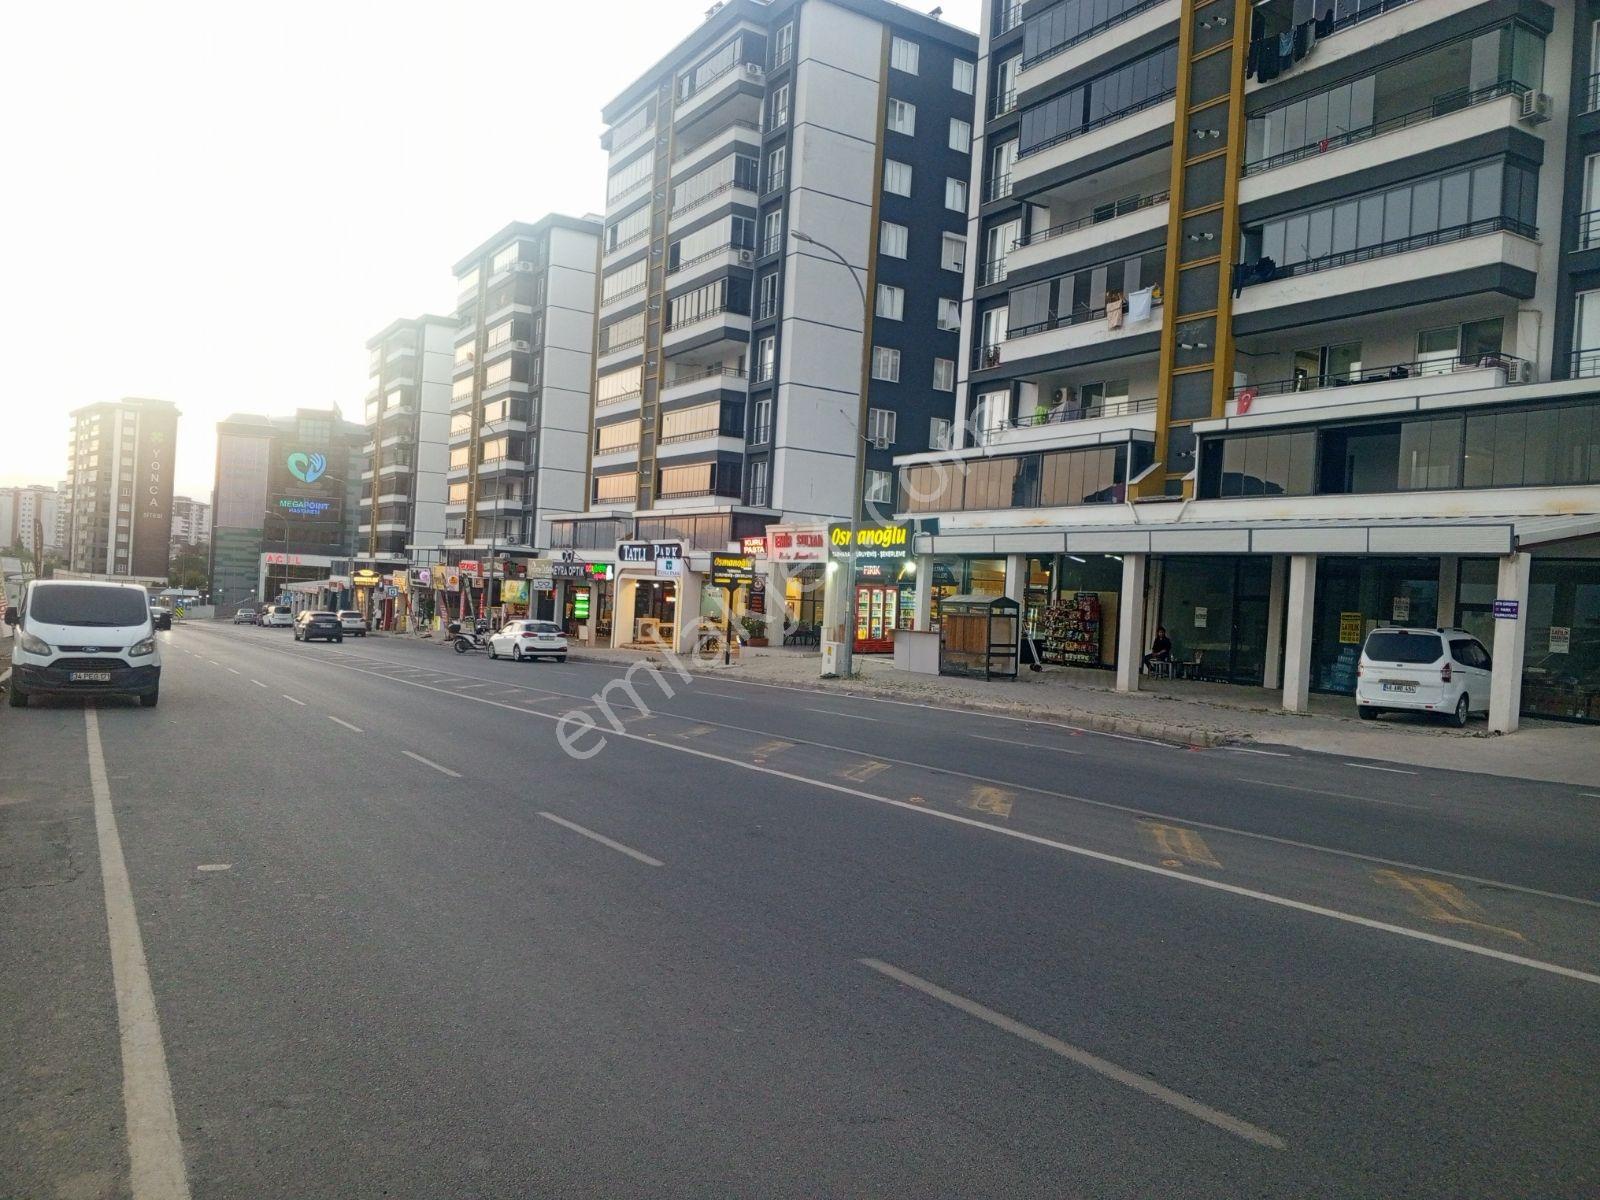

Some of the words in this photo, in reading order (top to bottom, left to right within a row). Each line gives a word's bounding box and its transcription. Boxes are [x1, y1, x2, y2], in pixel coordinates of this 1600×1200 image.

[149, 448, 161, 507] YONCA
[280, 500, 331, 511] MEGAPOINT
[623, 545, 646, 561] TATLI
[654, 544, 679, 560] PARK
